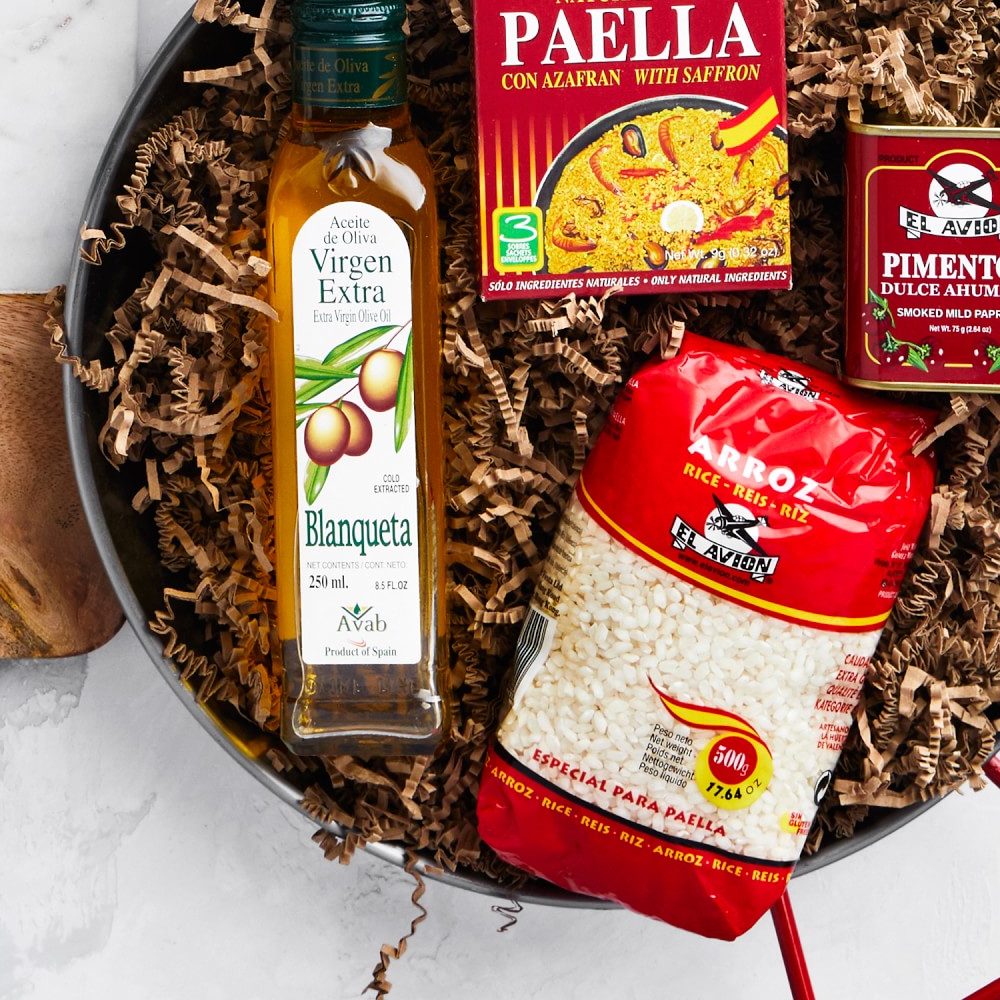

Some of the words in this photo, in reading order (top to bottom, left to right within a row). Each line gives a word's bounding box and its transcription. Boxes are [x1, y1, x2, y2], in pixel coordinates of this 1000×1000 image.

[499, 1, 762, 67] PAELLA
[317, 57, 331, 73] de
[334, 57, 369, 73] Oliva
[327, 78, 361, 94] Extra
[501, 72, 538, 90] CON
[542, 68, 621, 89] AZAFRAN
[634, 66, 679, 86] WITH
[682, 63, 761, 84] SAFFRON
[878, 154, 919, 164] PRODUCT
[330, 216, 370, 229] Aceite
[499, 213, 538, 243] 3
[906, 211, 931, 233] EL
[323, 231, 338, 245] de
[342, 230, 377, 245] Oliva
[665, 249, 686, 261] Net
[711, 248, 726, 259] 9g
[309, 248, 393, 281] Virgen
[881, 252, 1000, 280] PIMENT
[488, 279, 513, 292] SÓLO
[515, 278, 584, 291] INGREDIENTES
[585, 276, 640, 289] NATURALES
[650, 275, 678, 286] ONLY
[678, 273, 722, 285] NATURAL
[724, 270, 788, 283] INGREDIENTS
[880, 281, 940, 296] DULCE
[318, 278, 386, 304] Extra
[313, 309, 332, 323] Extra
[334, 309, 357, 326] Virgin
[358, 309, 378, 323] Olive
[380, 308, 391, 323] Oil
[897, 307, 943, 318] SMOKED
[945, 308, 972, 318] MILD
[952, 325, 960, 333] 75
[382, 474, 400, 483] COLD
[688, 435, 819, 503] ARROZ
[373, 484, 409, 494] EXTRACTED
[683, 462, 721, 488] RICE
[732, 483, 768, 507] REIS
[780, 503, 810, 524] RIZ
[304, 508, 413, 557] Blanqueta
[676, 522, 698, 549] EL
[703, 544, 772, 573] AVION
[306, 561, 320, 570] NET
[321, 561, 360, 569] CONTENTS
[309, 575, 328, 589] 250
[331, 575, 349, 589] ml.
[375, 581, 386, 590] 8.5
[337, 613, 387, 633] Avab
[325, 646, 360, 657] Product
[363, 646, 370, 657] of
[373, 646, 397, 659] Spain
[844, 653, 871, 669] CALIDA
[836, 669, 859, 684] EXTRA
[814, 698, 853, 715] KATEGORIE
[653, 723, 674, 739] Peso
[674, 733, 694, 747] neto
[646, 743, 669, 760] Poids
[670, 754, 684, 766] net
[649, 733, 664, 747] Net
[665, 741, 693, 758] weight
[817, 741, 825, 749] DE
[638, 761, 659, 777] Peso
[641, 752, 695, 781] Nettogewicht
[713, 744, 750, 777] 500g
[531, 747, 608, 793] ESPECIAL
[612, 785, 660, 814] PARA
[664, 806, 727, 837] PAELLA
[705, 781, 743, 801] 17.64
[490, 766, 534, 800] ARROZ
[541, 796, 573, 818] RICE
[580, 815, 611, 835] REIS
[619, 831, 646, 849] RIZ
[652, 845, 704, 867] ARROZ
[712, 858, 743, 877] RICE
[751, 869, 780, 884] REIS
